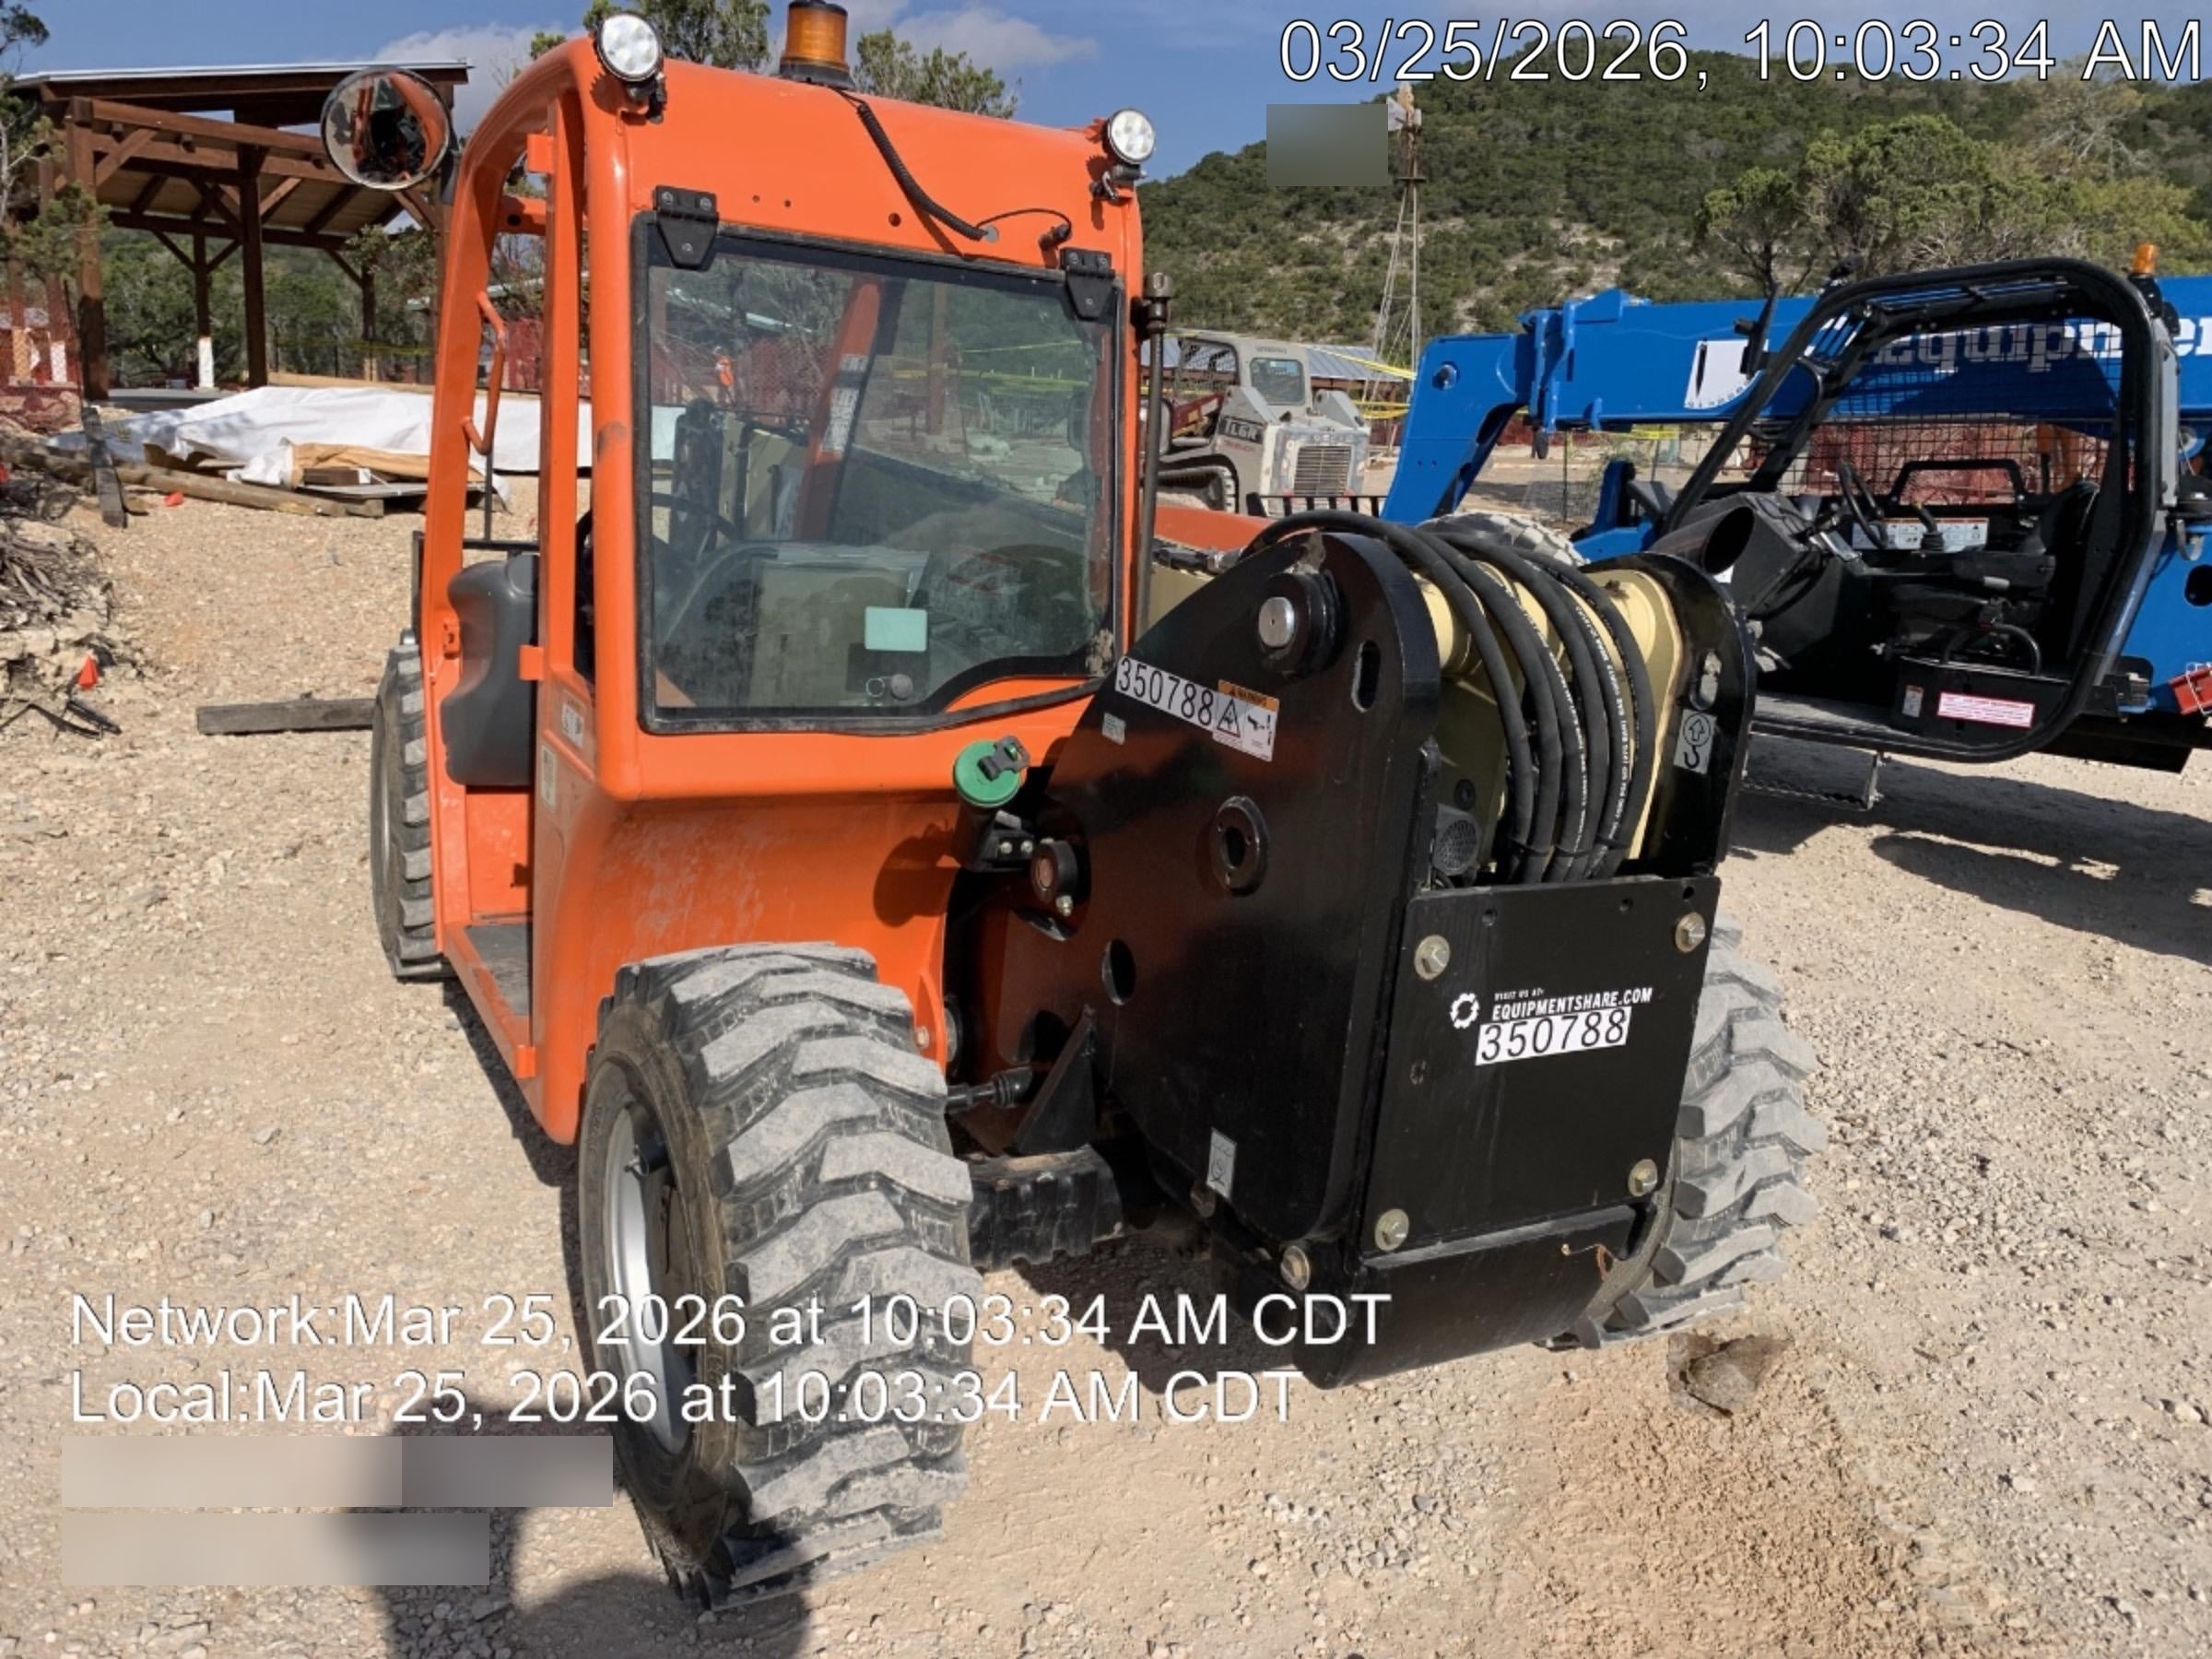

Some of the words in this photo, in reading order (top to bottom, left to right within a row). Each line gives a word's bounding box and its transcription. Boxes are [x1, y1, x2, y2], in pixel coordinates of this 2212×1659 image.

[1118, 657, 1214, 726] 350788
[1491, 987, 1653, 1022] EQUIPMENTSHARE.COM
[1481, 1008, 1627, 1062] 350788
